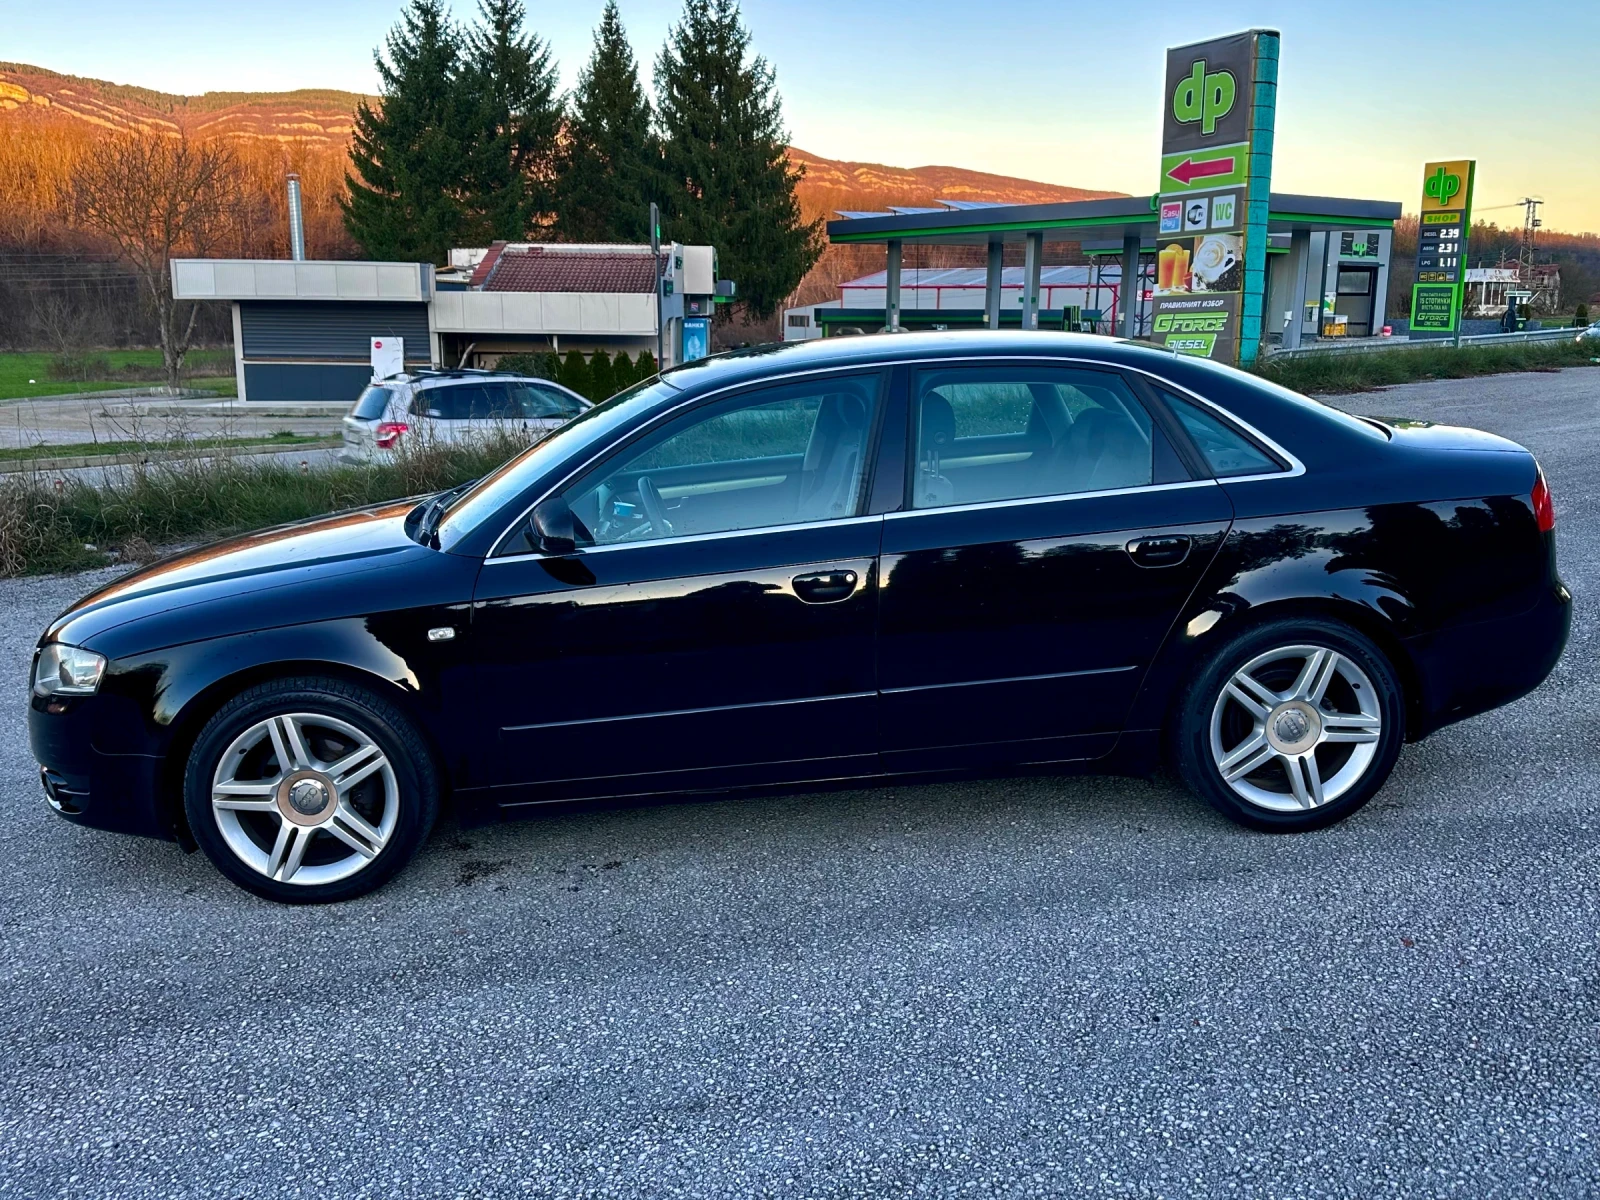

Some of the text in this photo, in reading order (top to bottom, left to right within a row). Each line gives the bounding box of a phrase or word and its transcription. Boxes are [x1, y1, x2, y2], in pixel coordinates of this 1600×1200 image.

[1173, 59, 1236, 135] dp
[1425, 166, 1460, 205] dp
[1163, 209, 1180, 219] Easy
[1216, 202, 1233, 221] WC
[1426, 214, 1457, 223] SHOP
[1162, 219, 1176, 229] Pay
[1440, 228, 1460, 238] 2.39
[1438, 243, 1458, 253] 2.31
[1440, 257, 1457, 267] 1.11
[1160, 300, 1224, 309] ПРАВИЛНИЯТ ИЗБОР
[1167, 340, 1207, 349] DIESEL
